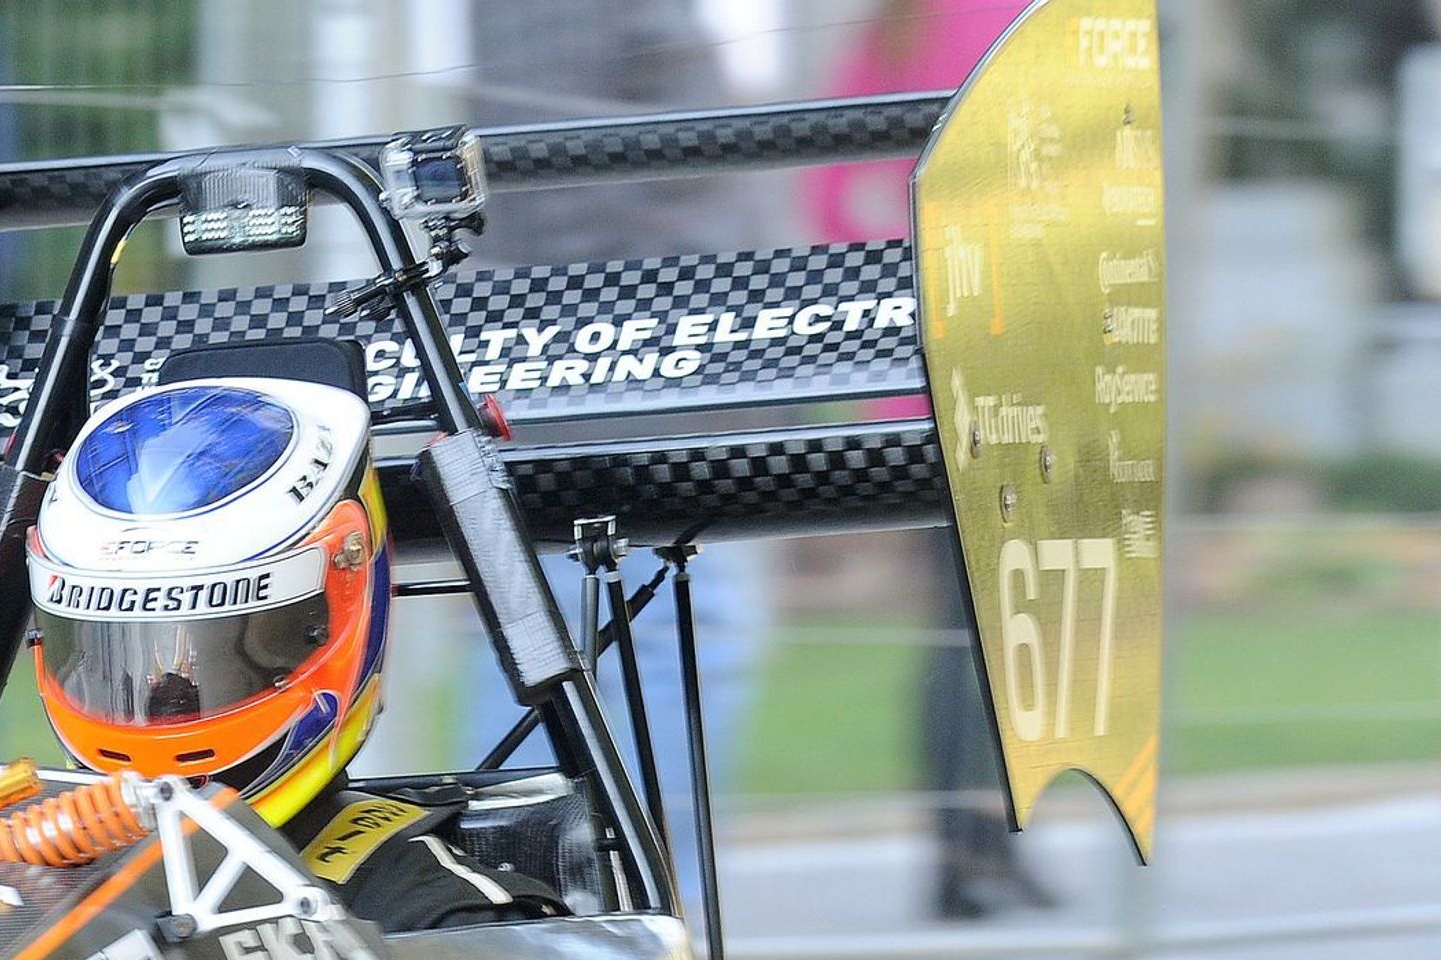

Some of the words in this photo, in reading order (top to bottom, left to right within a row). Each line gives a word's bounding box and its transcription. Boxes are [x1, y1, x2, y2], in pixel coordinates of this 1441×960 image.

[574, 318, 659, 354] OF
[673, 296, 916, 347] ELECTR
[366, 349, 704, 403] GIEERING
[47, 571, 271, 613] BRIDGESTONE
[999, 538, 1118, 742] 677
